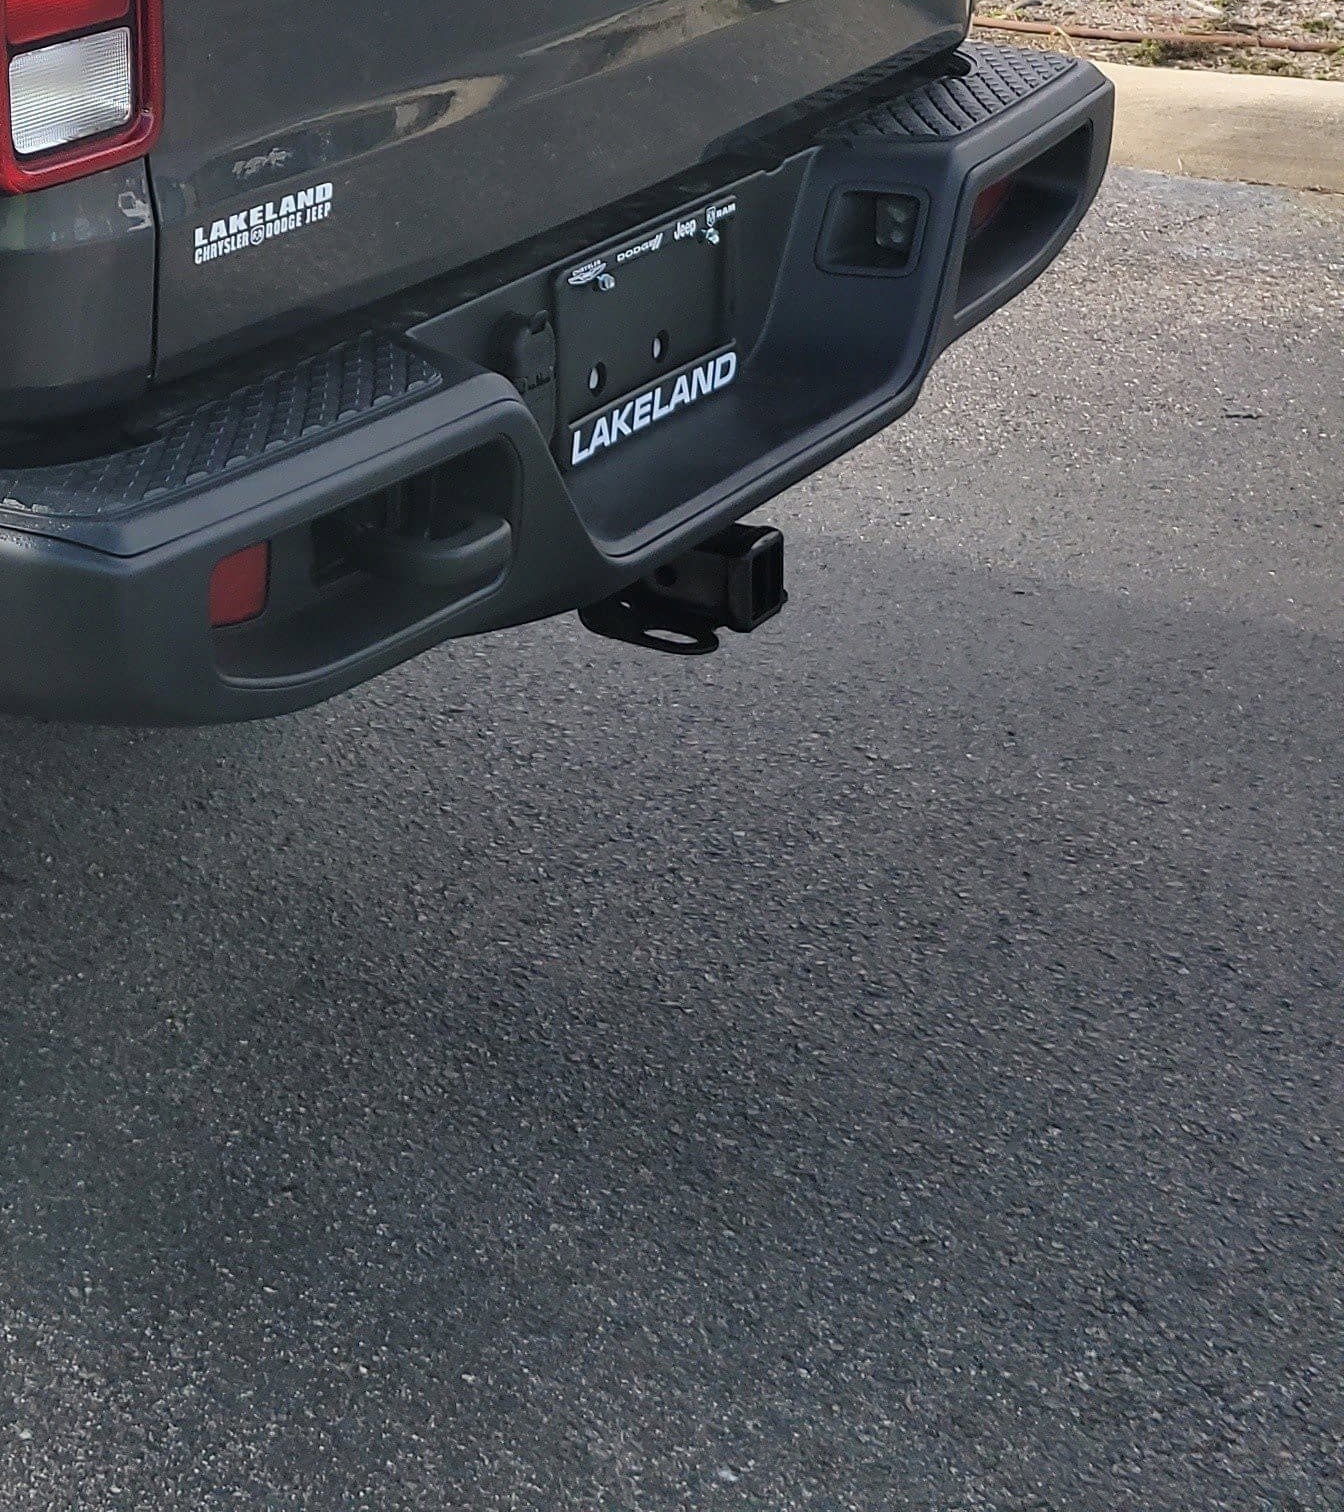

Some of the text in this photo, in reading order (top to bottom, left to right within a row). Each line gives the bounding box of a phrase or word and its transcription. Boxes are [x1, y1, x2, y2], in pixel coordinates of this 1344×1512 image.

[194, 182, 333, 248] LAKELAND
[194, 201, 331, 265] CHRYSLER DODGE JEEP
[673, 219, 696, 240] Jeep
[716, 203, 736, 219] RAM
[617, 237, 658, 262] DODGE
[572, 351, 737, 465] LAKELAND
